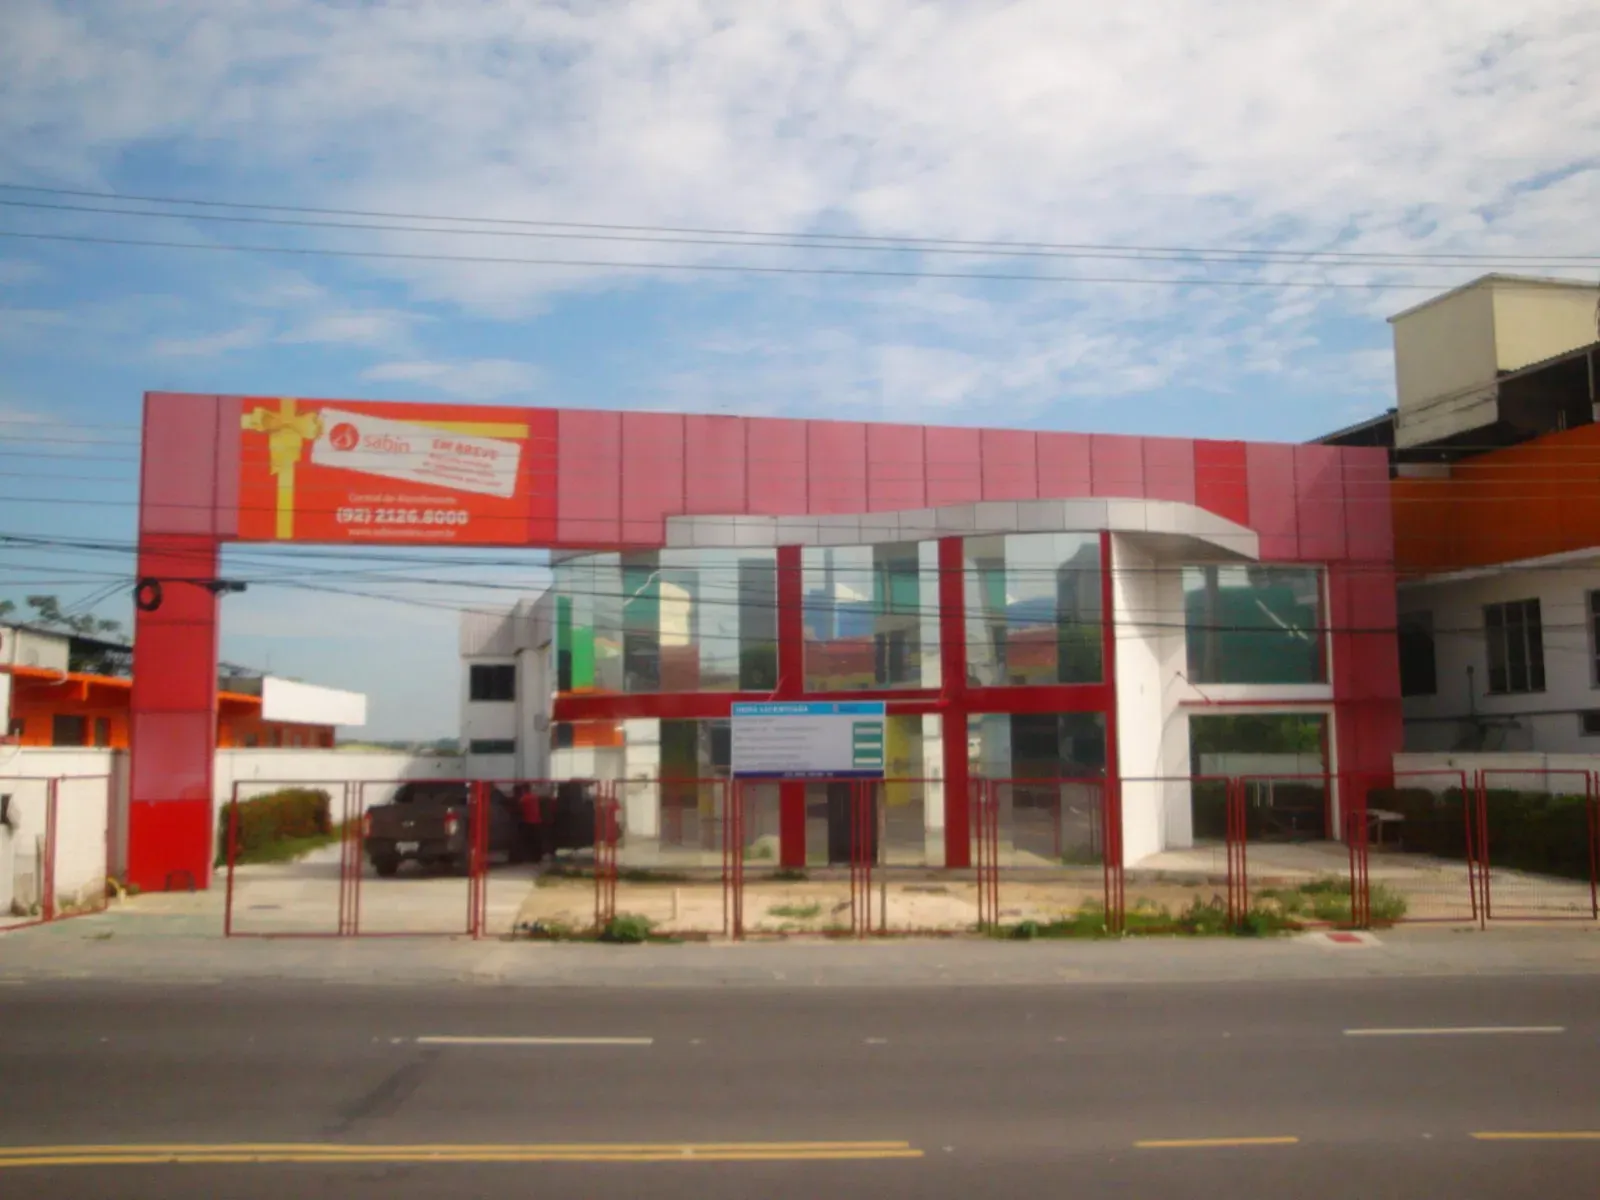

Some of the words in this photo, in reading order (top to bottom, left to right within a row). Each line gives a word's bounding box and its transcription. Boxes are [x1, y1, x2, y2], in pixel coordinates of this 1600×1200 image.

[364, 432, 410, 454] sabin
[455, 441, 500, 461] BREVE
[336, 506, 371, 524] (92)
